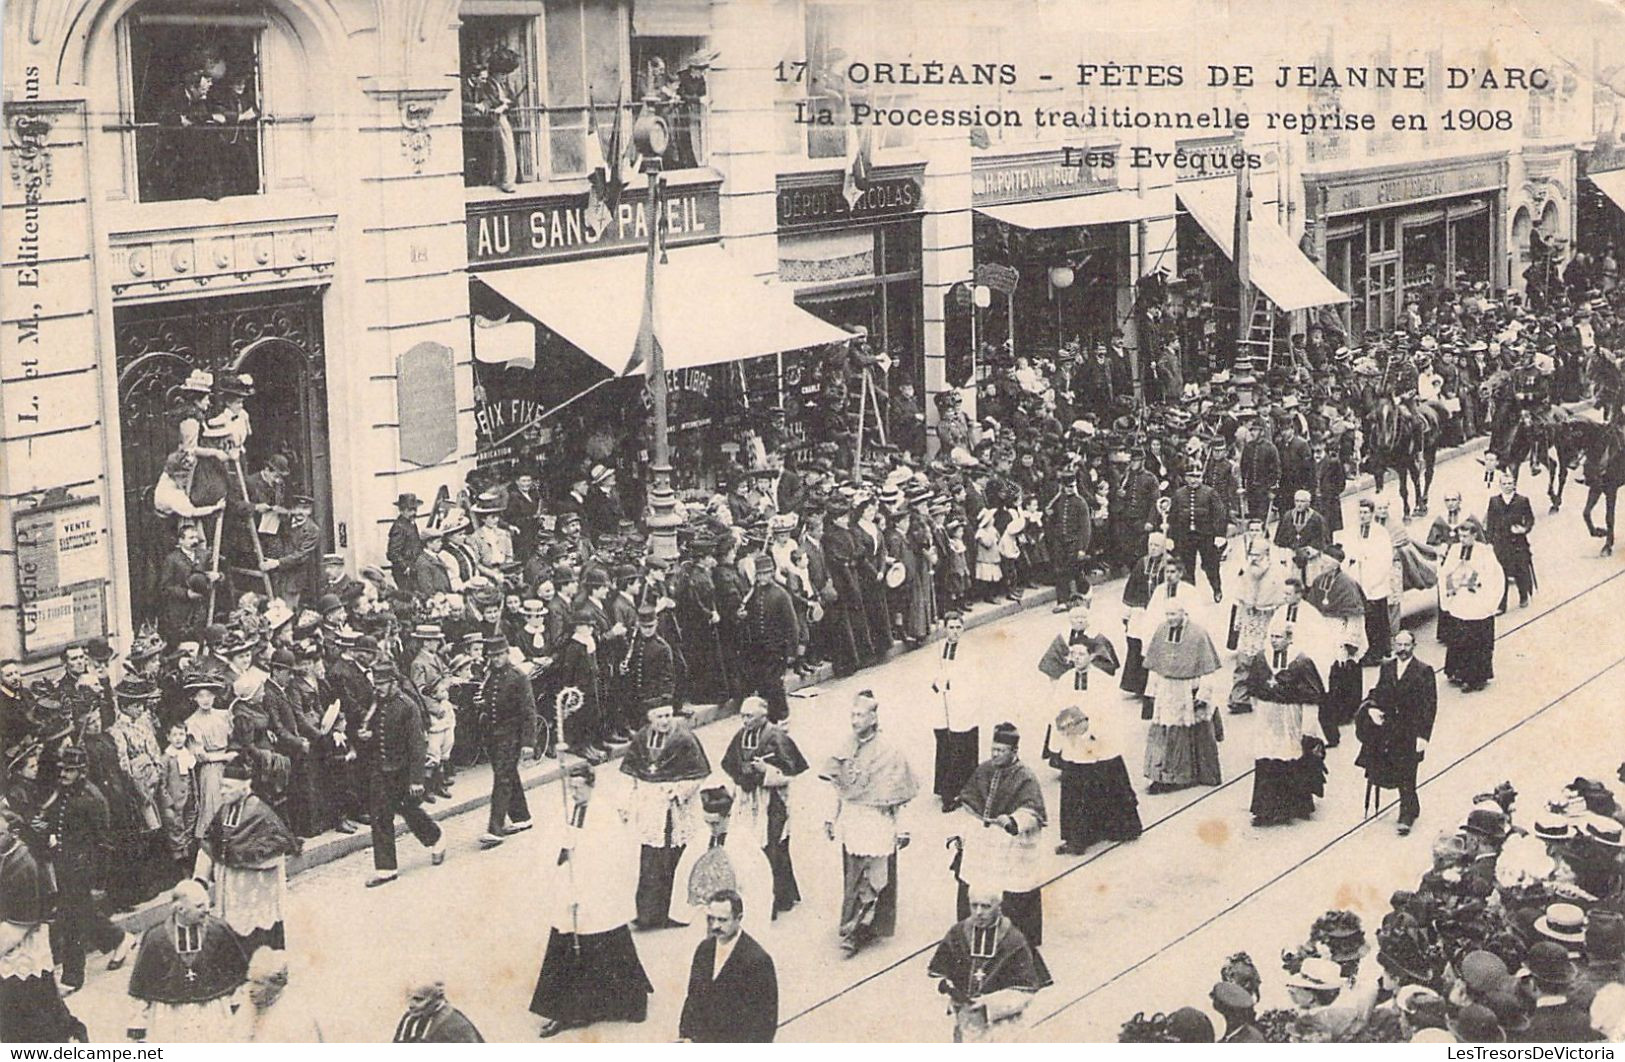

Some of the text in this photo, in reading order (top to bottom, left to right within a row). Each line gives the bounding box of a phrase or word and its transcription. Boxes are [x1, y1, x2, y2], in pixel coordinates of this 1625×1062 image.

[478, 215, 510, 256] AU
[617, 197, 705, 240] PAEIL
[64, 520, 91, 533] VENTE
